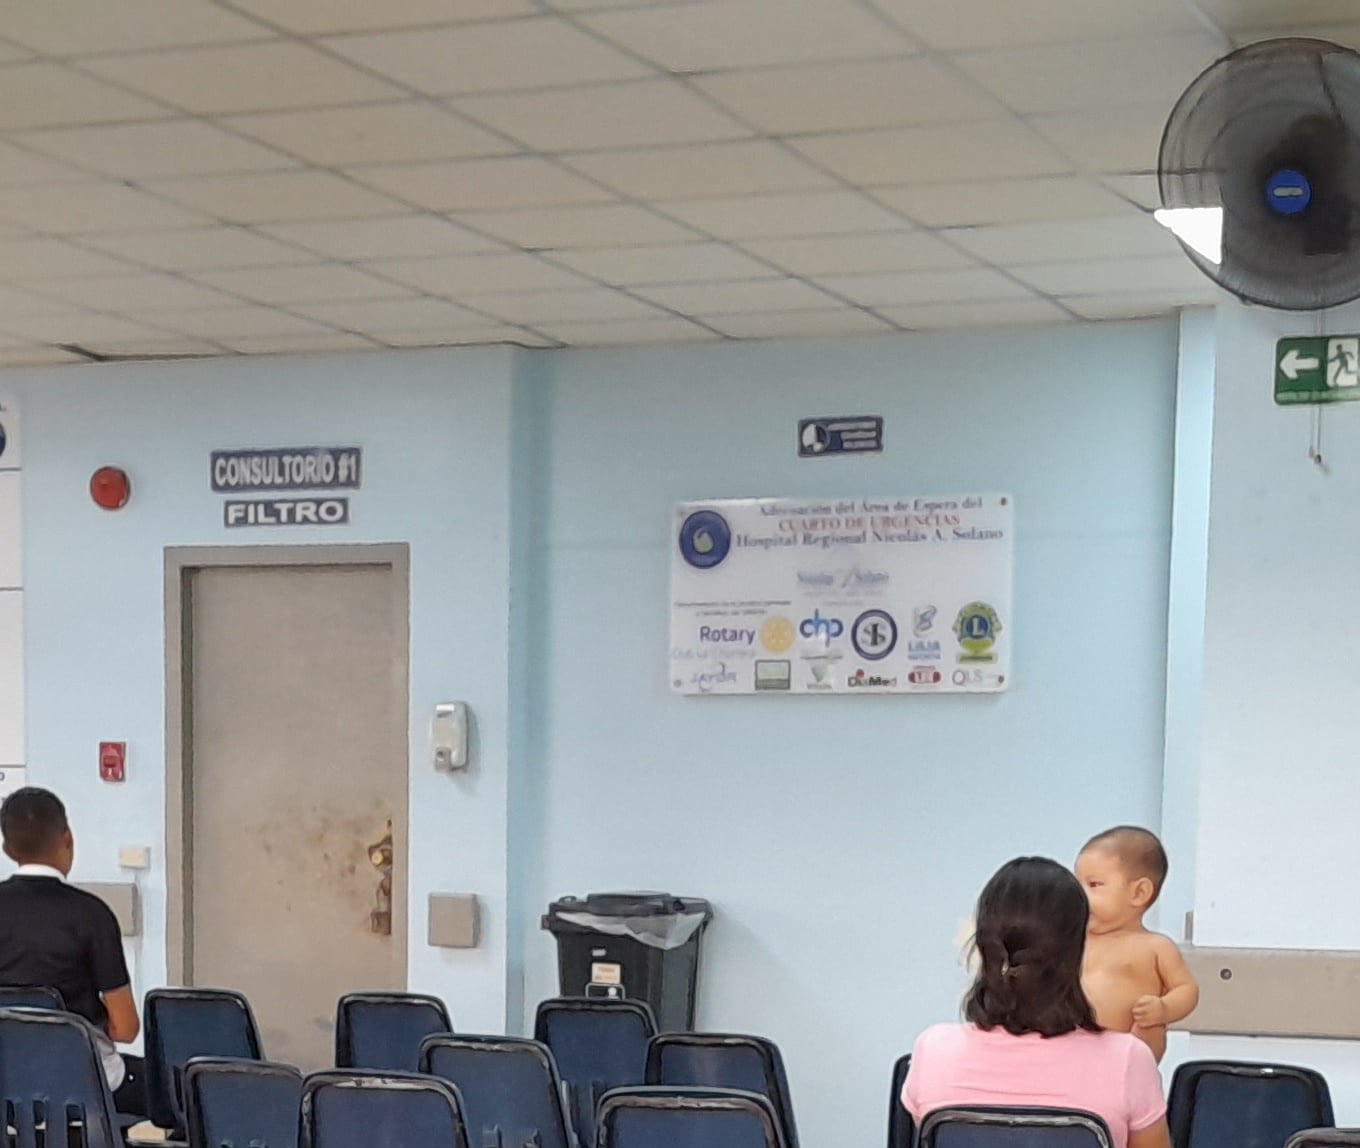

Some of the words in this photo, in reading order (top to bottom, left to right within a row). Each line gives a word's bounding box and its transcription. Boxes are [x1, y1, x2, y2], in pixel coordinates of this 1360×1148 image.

[214, 453, 335, 487] CONSULTORIO
[337, 453, 358, 484] #1
[227, 501, 344, 525] FILTRO
[835, 502, 855, 515] del
[894, 500, 910, 512] de
[913, 499, 958, 515] Espera
[962, 497, 983, 509] del
[778, 517, 840, 532] CUARTO
[845, 516, 864, 530] DE
[869, 514, 961, 529] URGENCIAS
[736, 533, 797, 550] Hospital
[802, 530, 867, 549] Regional
[952, 527, 1004, 540] Solano
[699, 625, 756, 645] Rotary
